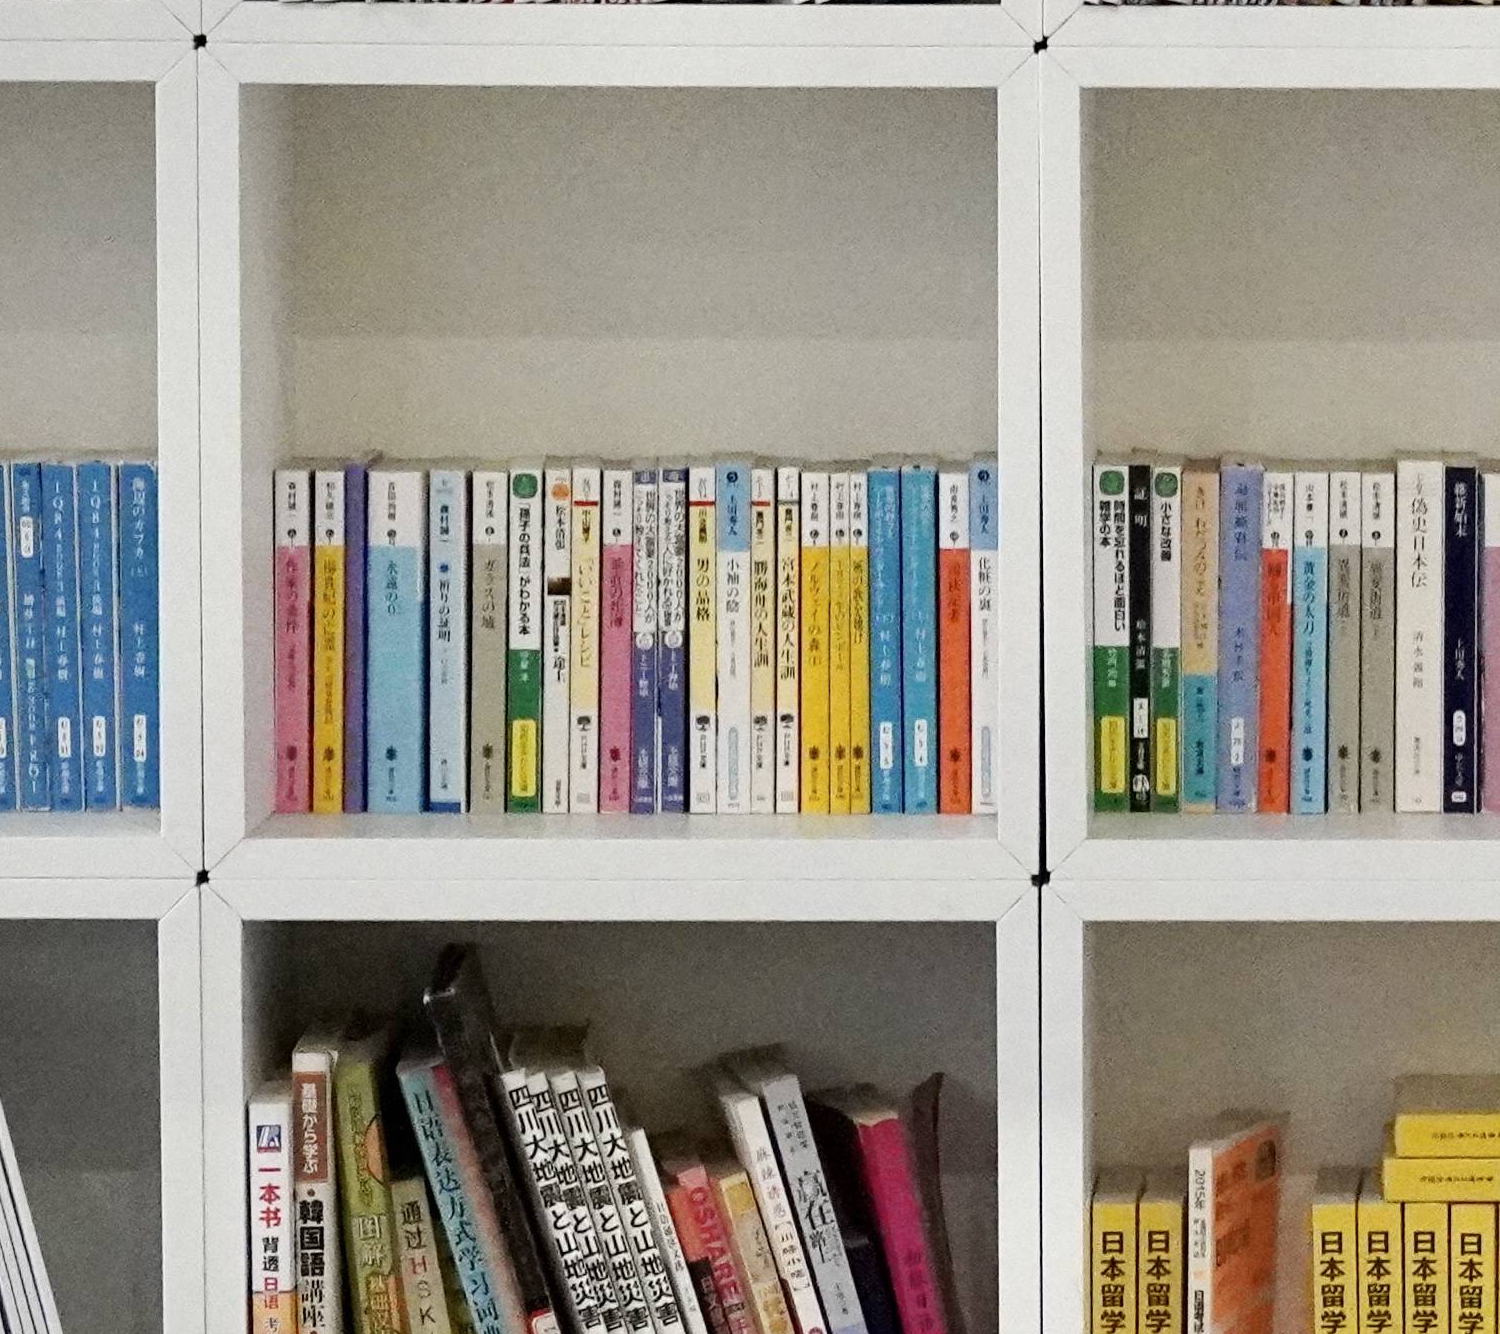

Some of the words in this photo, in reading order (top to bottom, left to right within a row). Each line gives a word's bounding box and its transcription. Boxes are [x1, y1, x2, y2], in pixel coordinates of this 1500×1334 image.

[695, 557, 710, 622] 男の品格
[258, 1165, 283, 1229] 一本书
[559, 1088, 649, 1331] 四川大地震と山地災害
[588, 1085, 678, 1327] 四川大地震と山地災害
